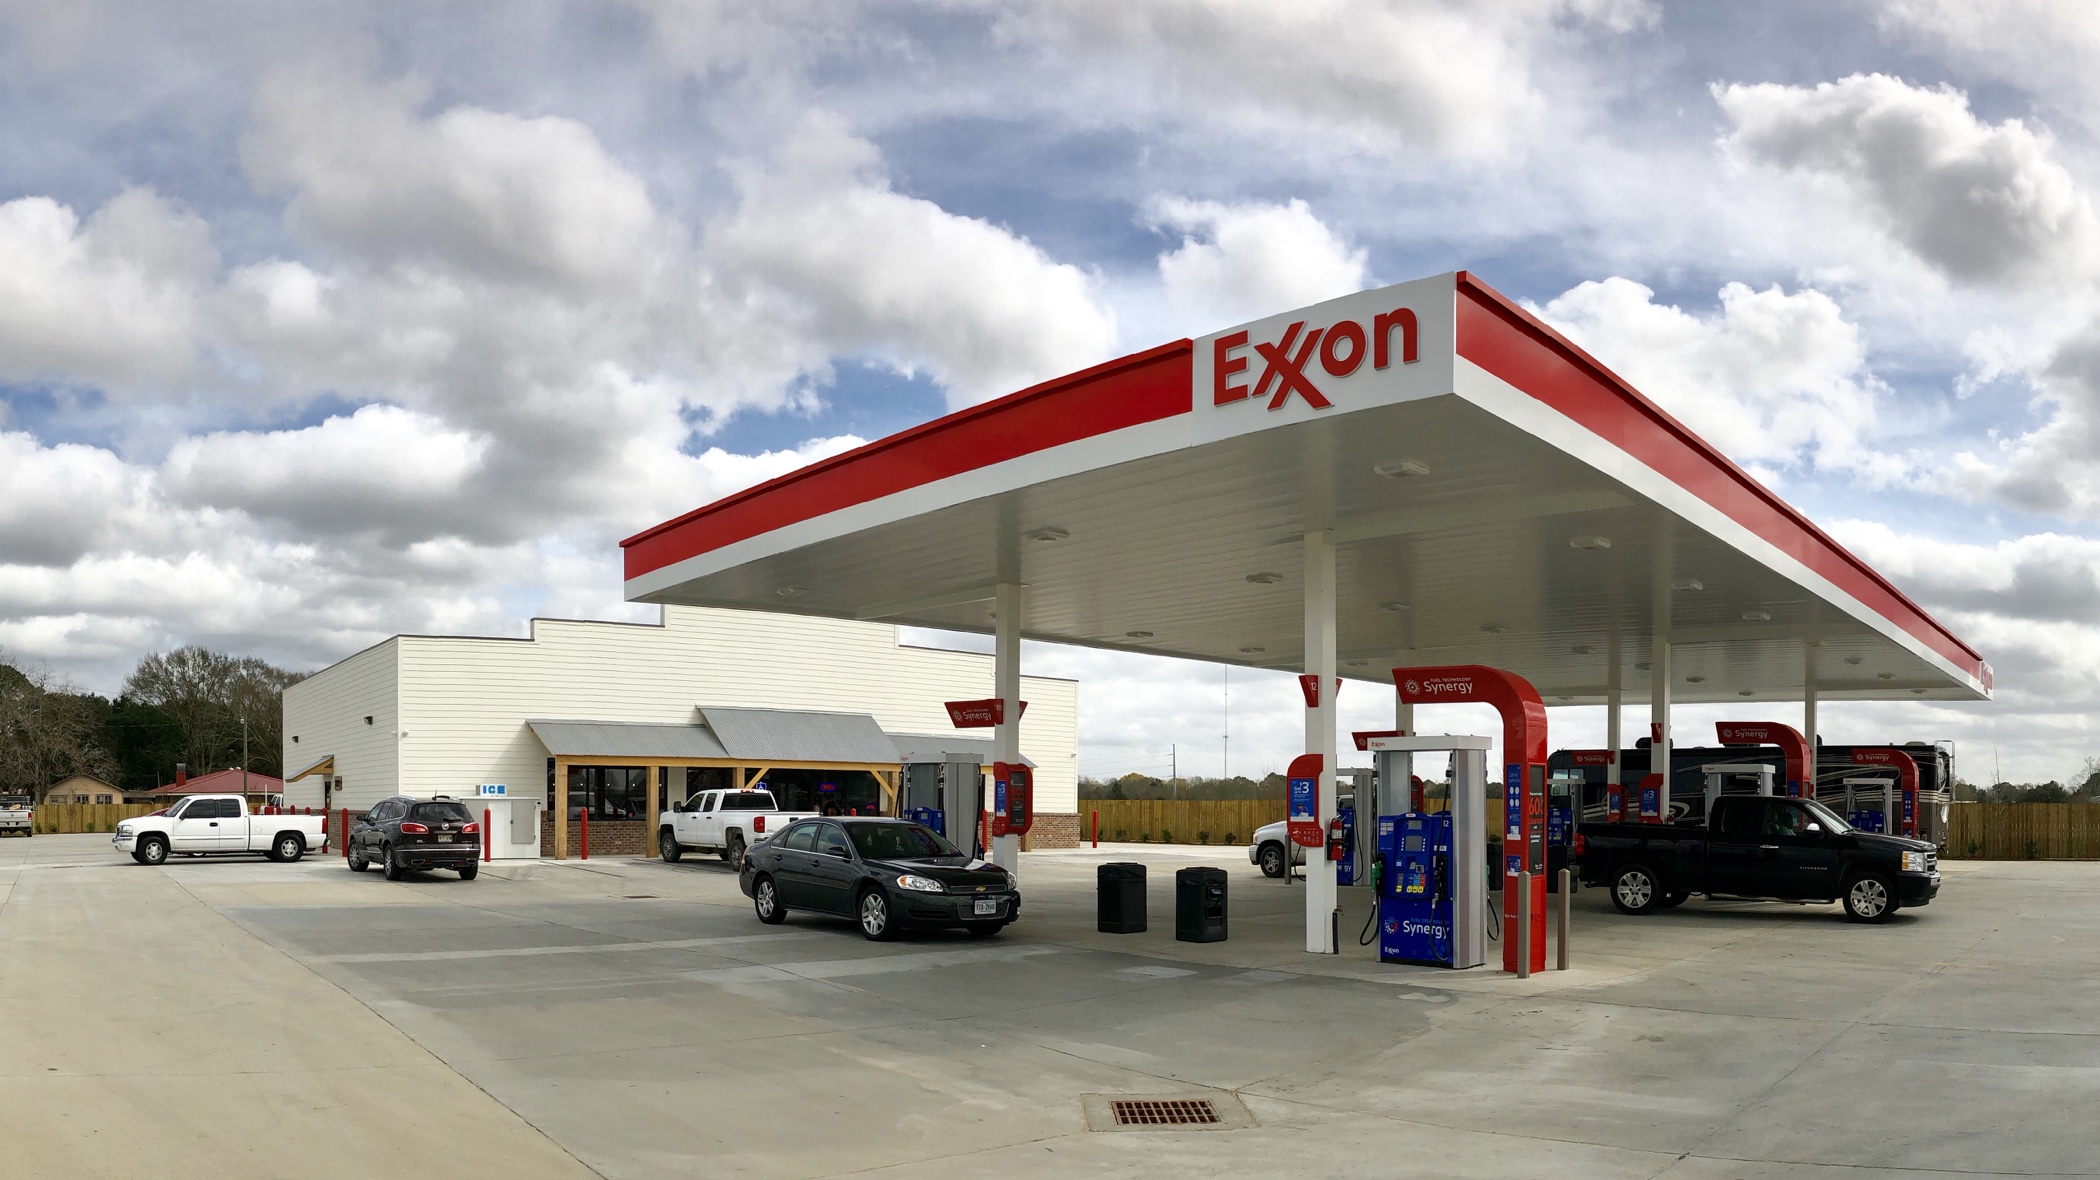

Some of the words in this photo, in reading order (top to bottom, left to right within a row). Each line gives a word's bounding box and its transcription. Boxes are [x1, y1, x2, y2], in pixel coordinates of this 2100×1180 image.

[1213, 307, 1420, 411] Exxon
[1310, 682, 1317, 690] 12
[1423, 681, 1473, 695] Synergy
[995, 704, 1002, 712] 10
[963, 711, 992, 721] Synergy
[1735, 730, 1768, 738] Synergy
[483, 785, 505, 794] ICE
[1403, 921, 1450, 939] Synergy
[1384, 946, 1400, 954] Exxon
